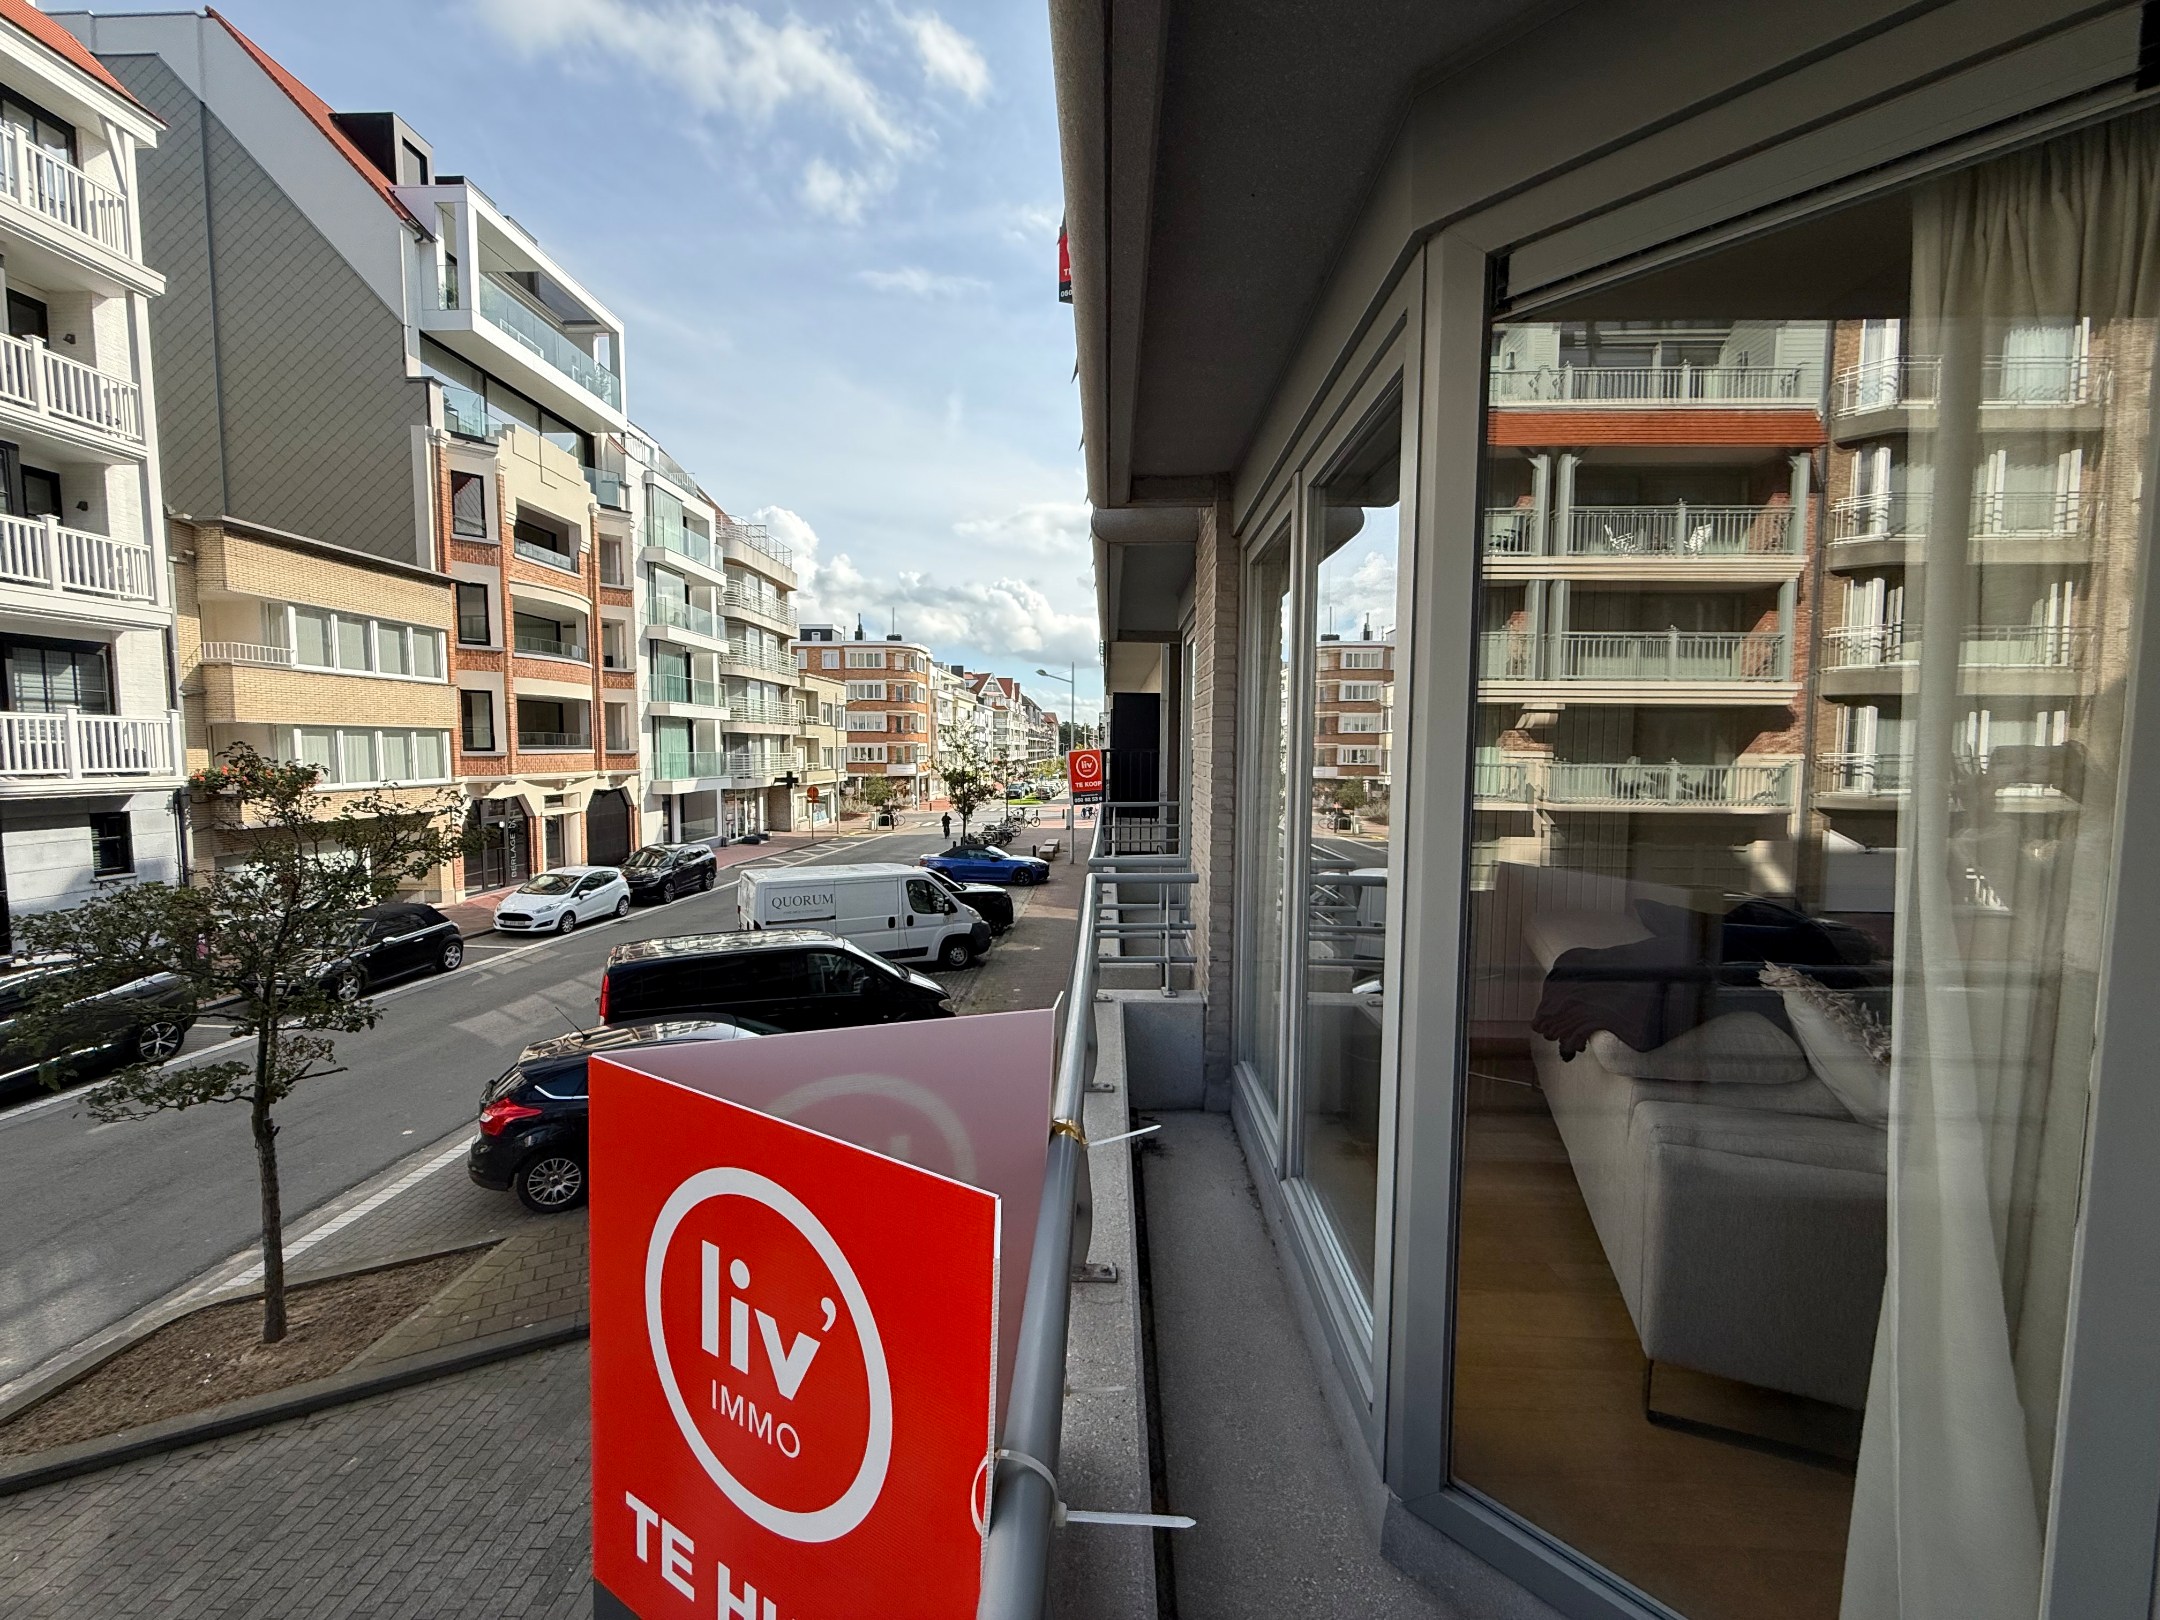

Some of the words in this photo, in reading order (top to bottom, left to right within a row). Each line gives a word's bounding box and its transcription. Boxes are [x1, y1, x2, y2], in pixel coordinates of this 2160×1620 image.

[510, 833, 518, 878] BERLAGE
[771, 893, 834, 910] QUORUM
[702, 1239, 837, 1401] liv'
[711, 1379, 801, 1459] IMMO
[625, 1490, 695, 1603] TE
